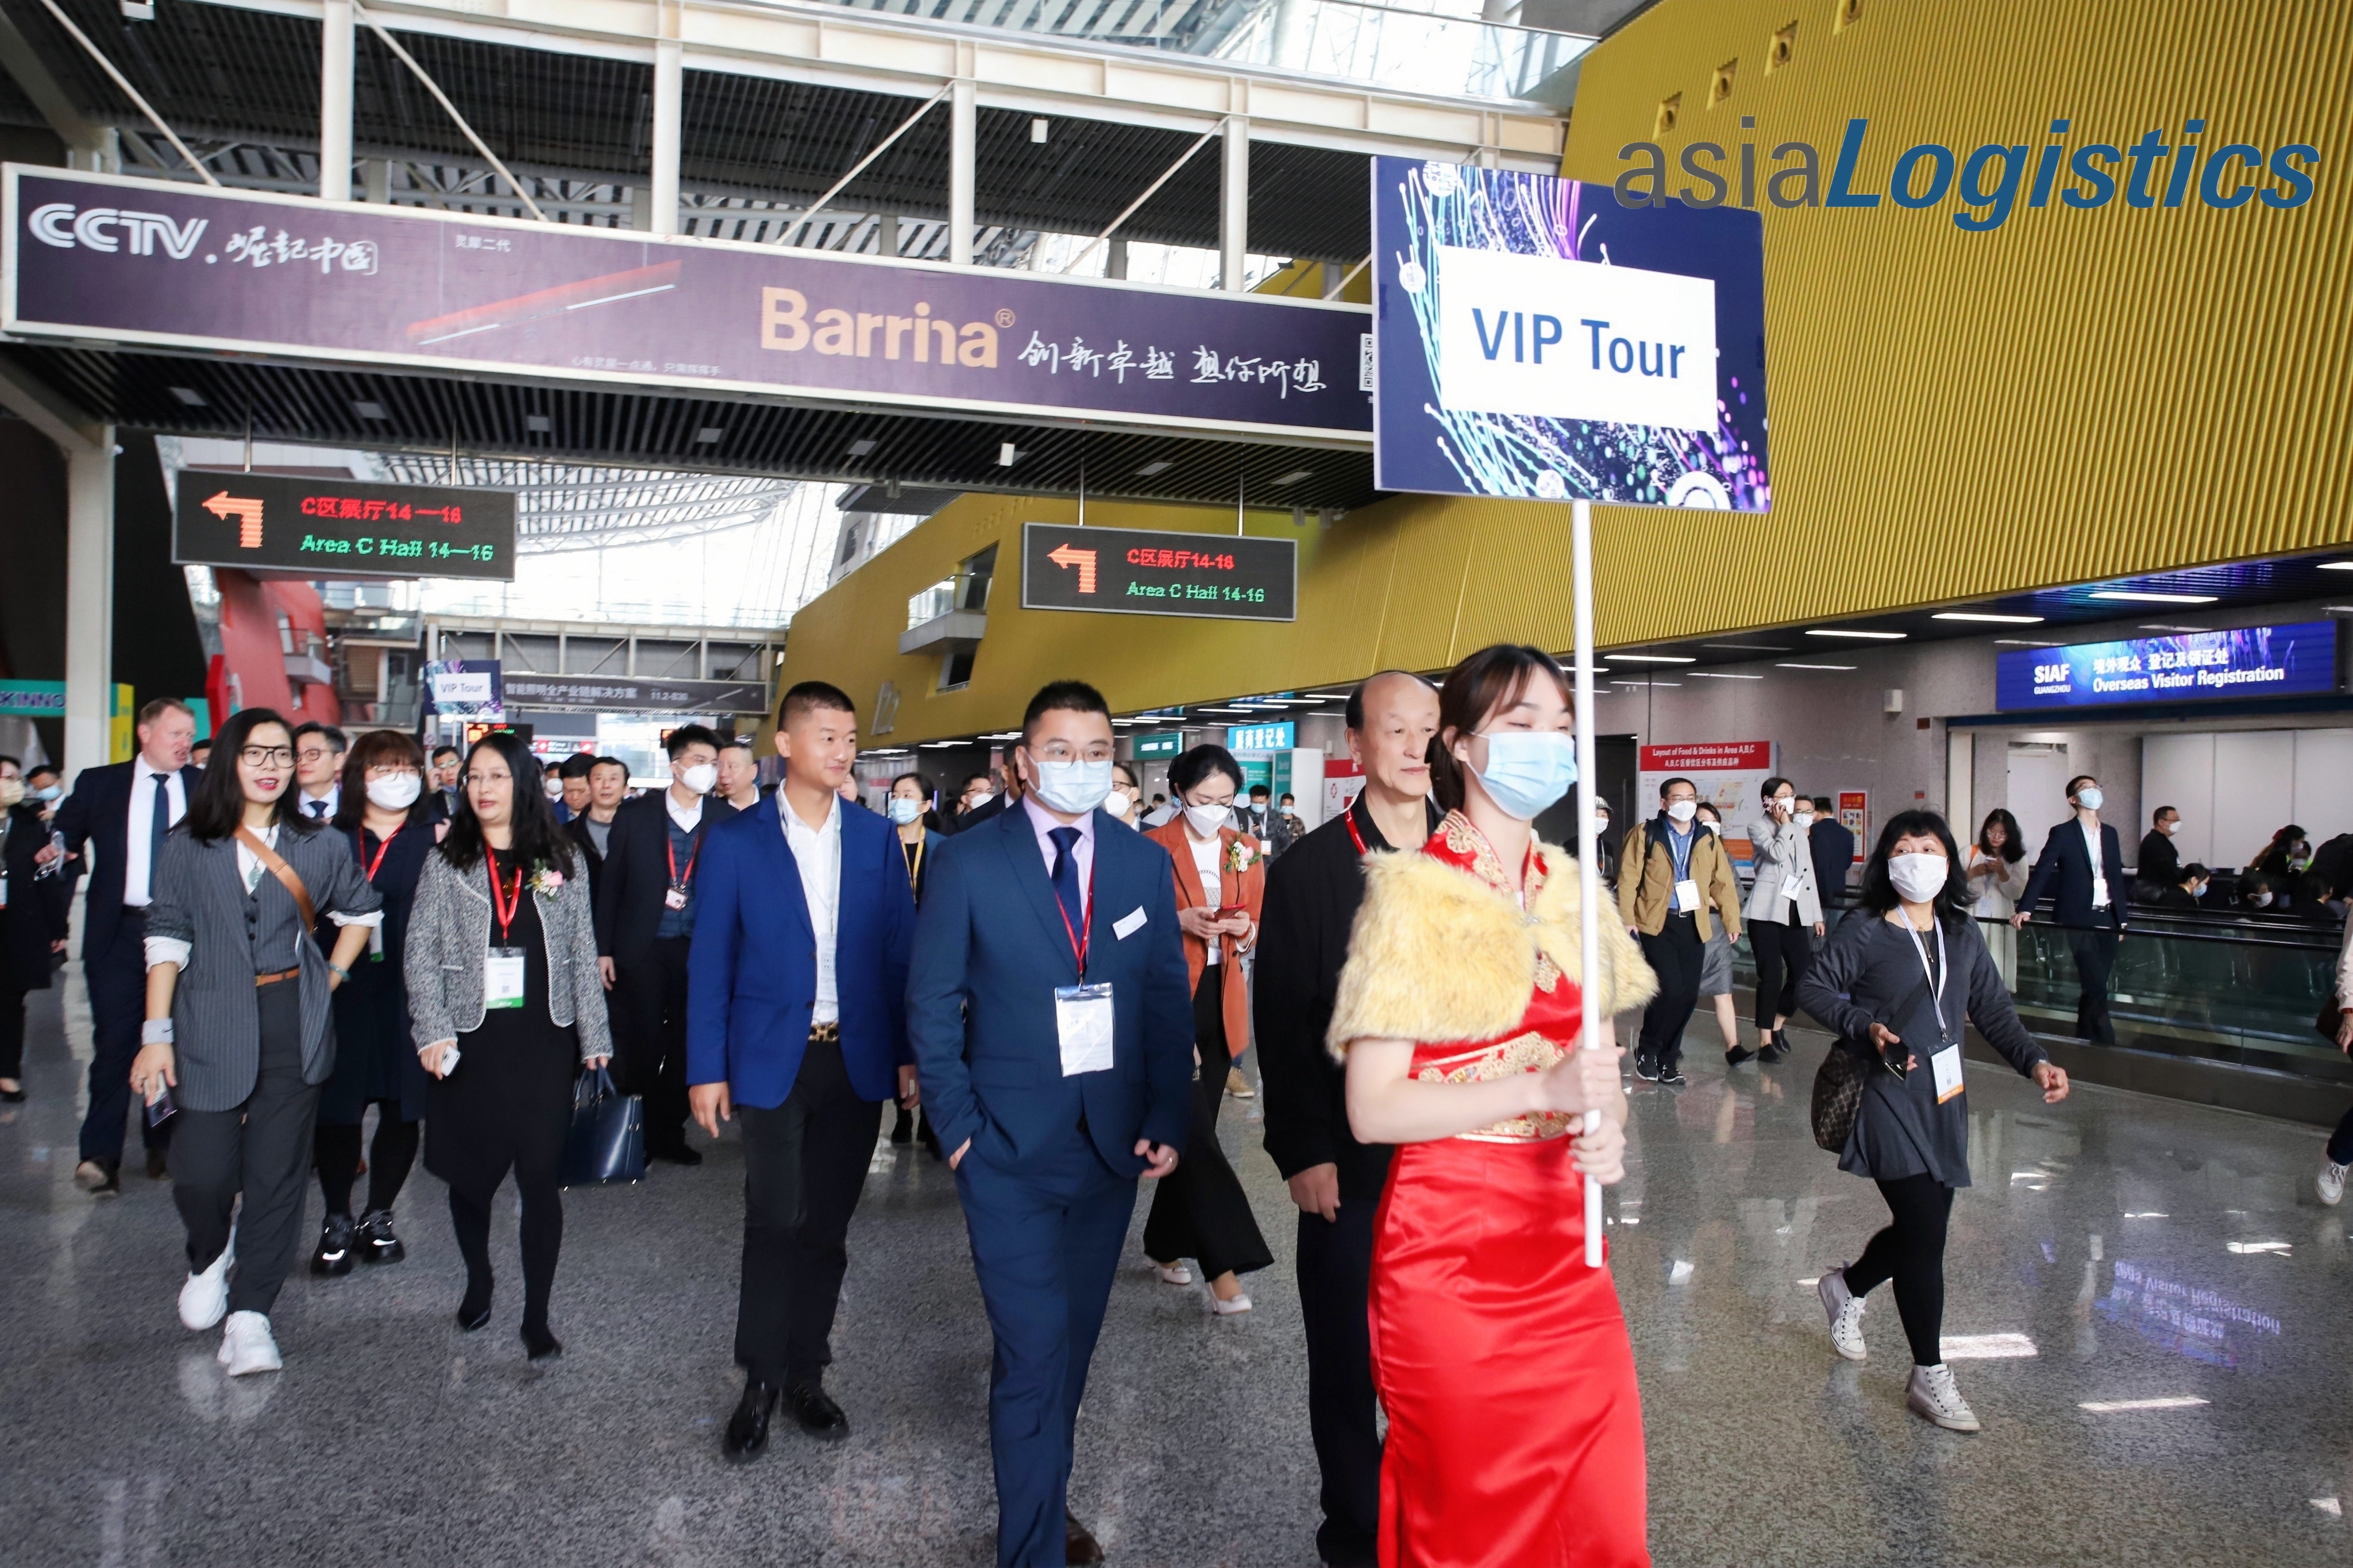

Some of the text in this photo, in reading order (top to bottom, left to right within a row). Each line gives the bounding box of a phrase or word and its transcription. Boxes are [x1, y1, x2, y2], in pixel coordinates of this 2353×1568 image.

[1472, 307, 1686, 379] VIP Tour
[300, 534, 352, 554] Area
[355, 536, 375, 555] C
[379, 538, 423, 557] Hall
[1127, 581, 1265, 603] Area C Hall 14-16
[2034, 663, 2070, 683] SIAF
[2093, 665, 2285, 693] Overseas Visitor Registration
[440, 683, 483, 693] VIP Tour
[2034, 684, 2071, 694] GUANGZHOU
[1653, 748, 1671, 758] Layout
[1672, 747, 1678, 756] of
[1678, 747, 1692, 755] Food
[1699, 747, 1716, 755] Drinks
[1717, 746, 1723, 755] in
[1724, 746, 1738, 754] Area
